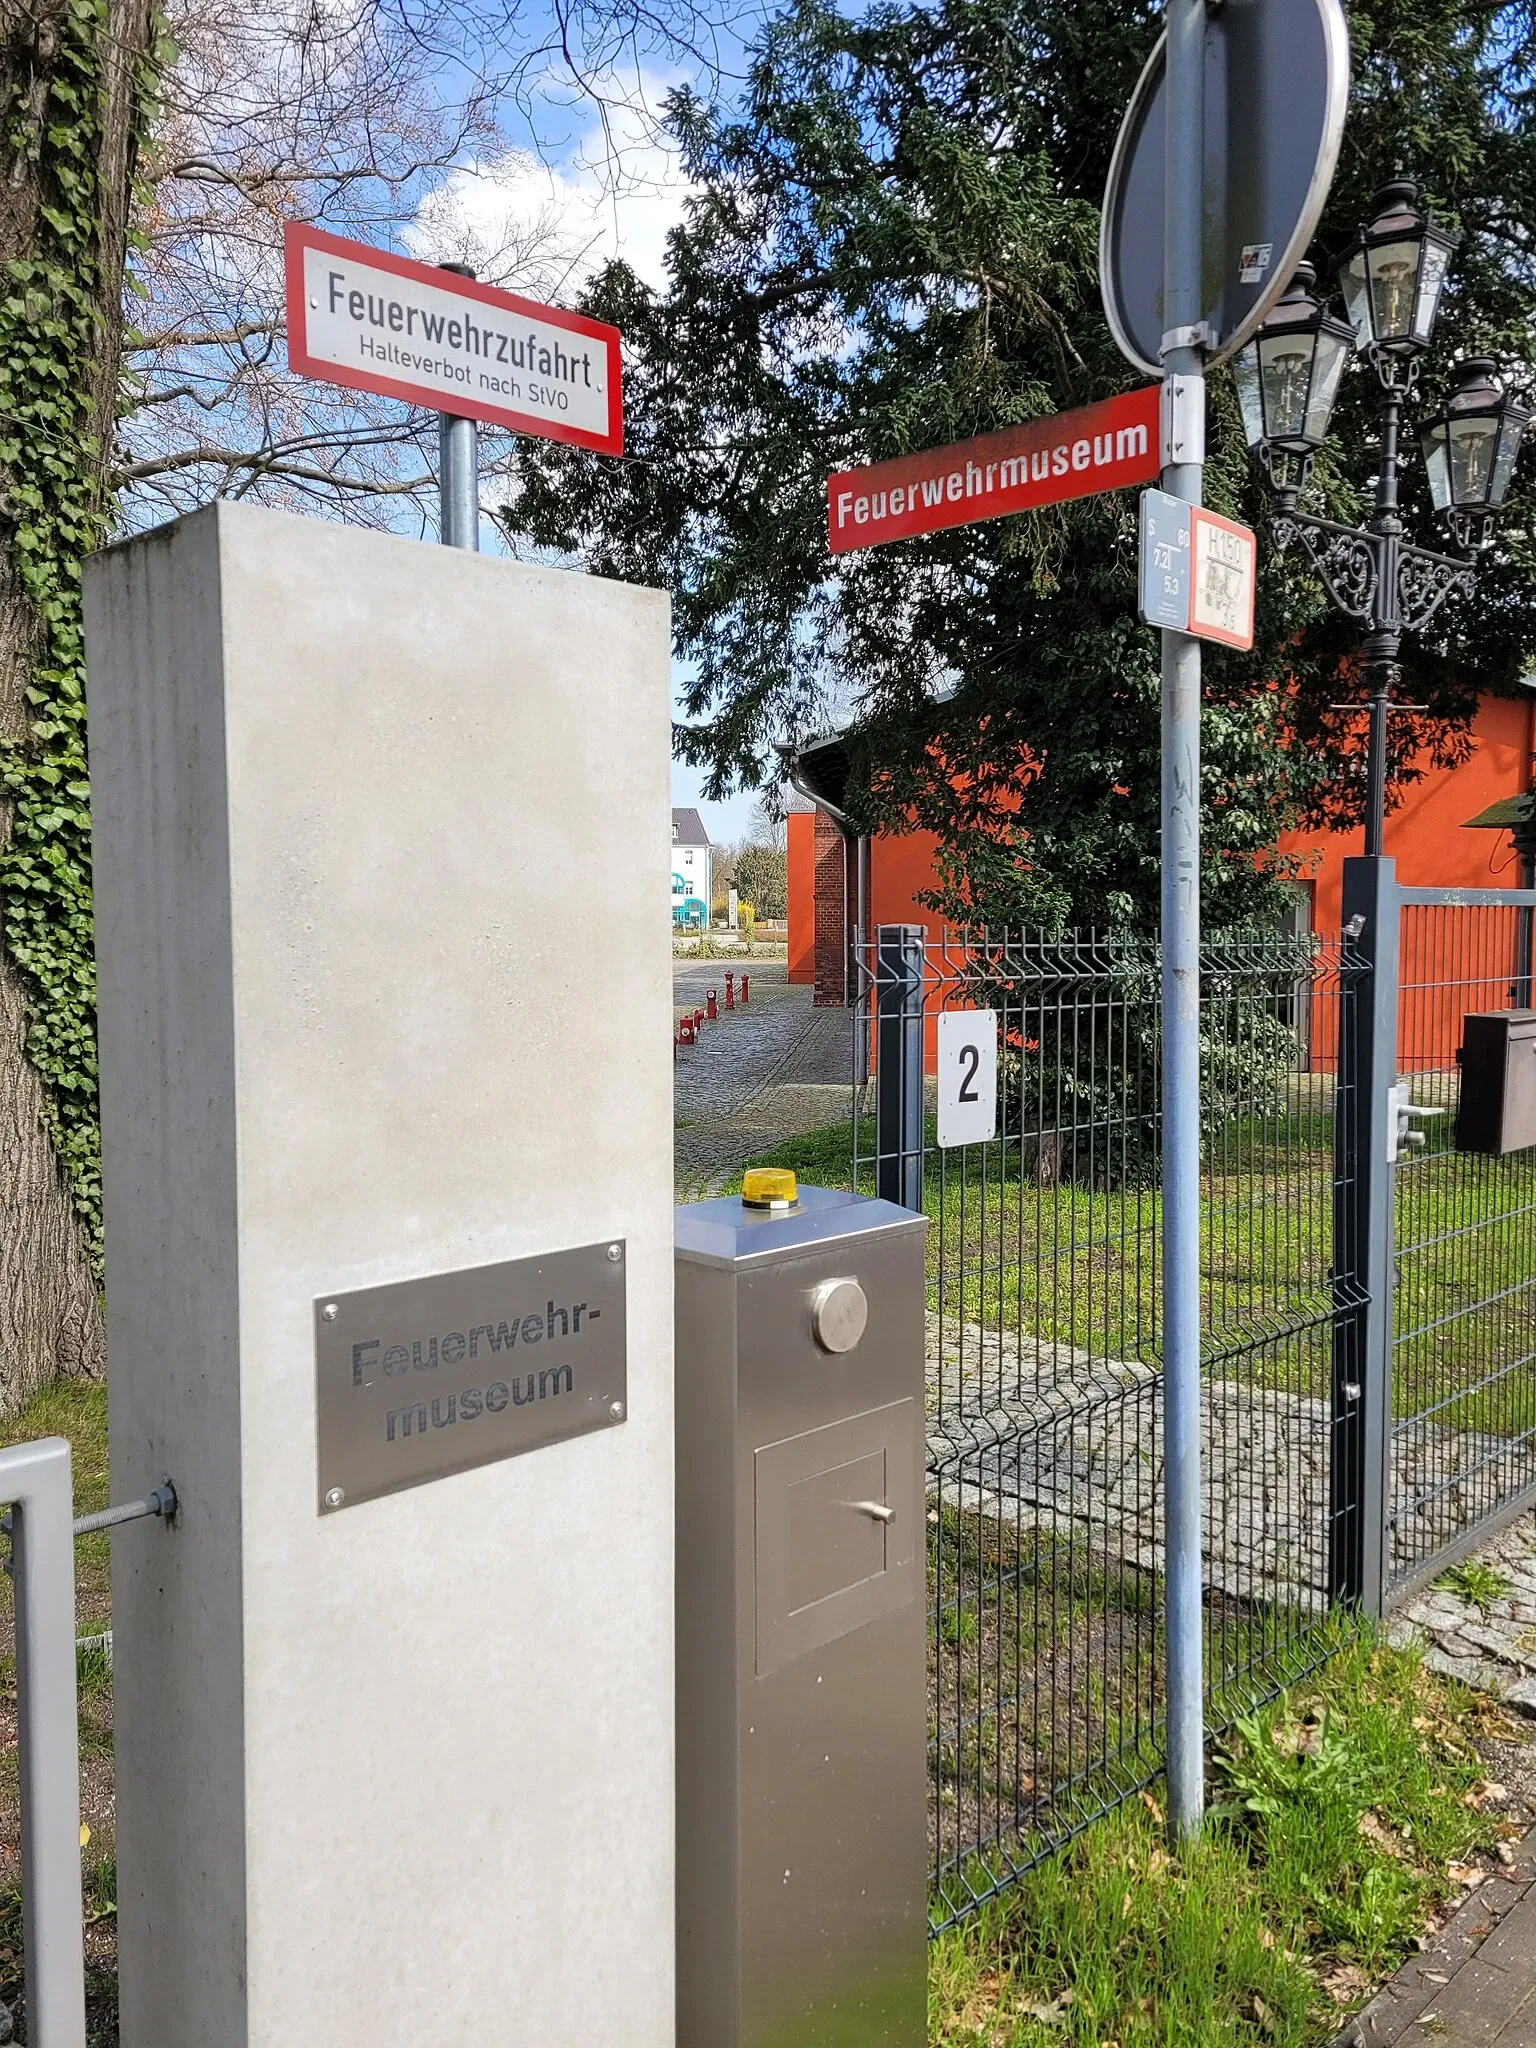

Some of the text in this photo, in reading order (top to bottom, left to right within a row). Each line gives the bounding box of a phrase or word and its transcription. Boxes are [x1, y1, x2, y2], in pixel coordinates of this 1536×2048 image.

[328, 271, 592, 388] Feuerwehrzufahrt
[360, 334, 568, 411] Halteverbot nach StVO
[837, 424, 1148, 528] Feuerwehrmuseum
[958, 1044, 979, 1103] 2
[352, 1300, 601, 1386] Feuerwehr-
[386, 1364, 573, 1442] museum
